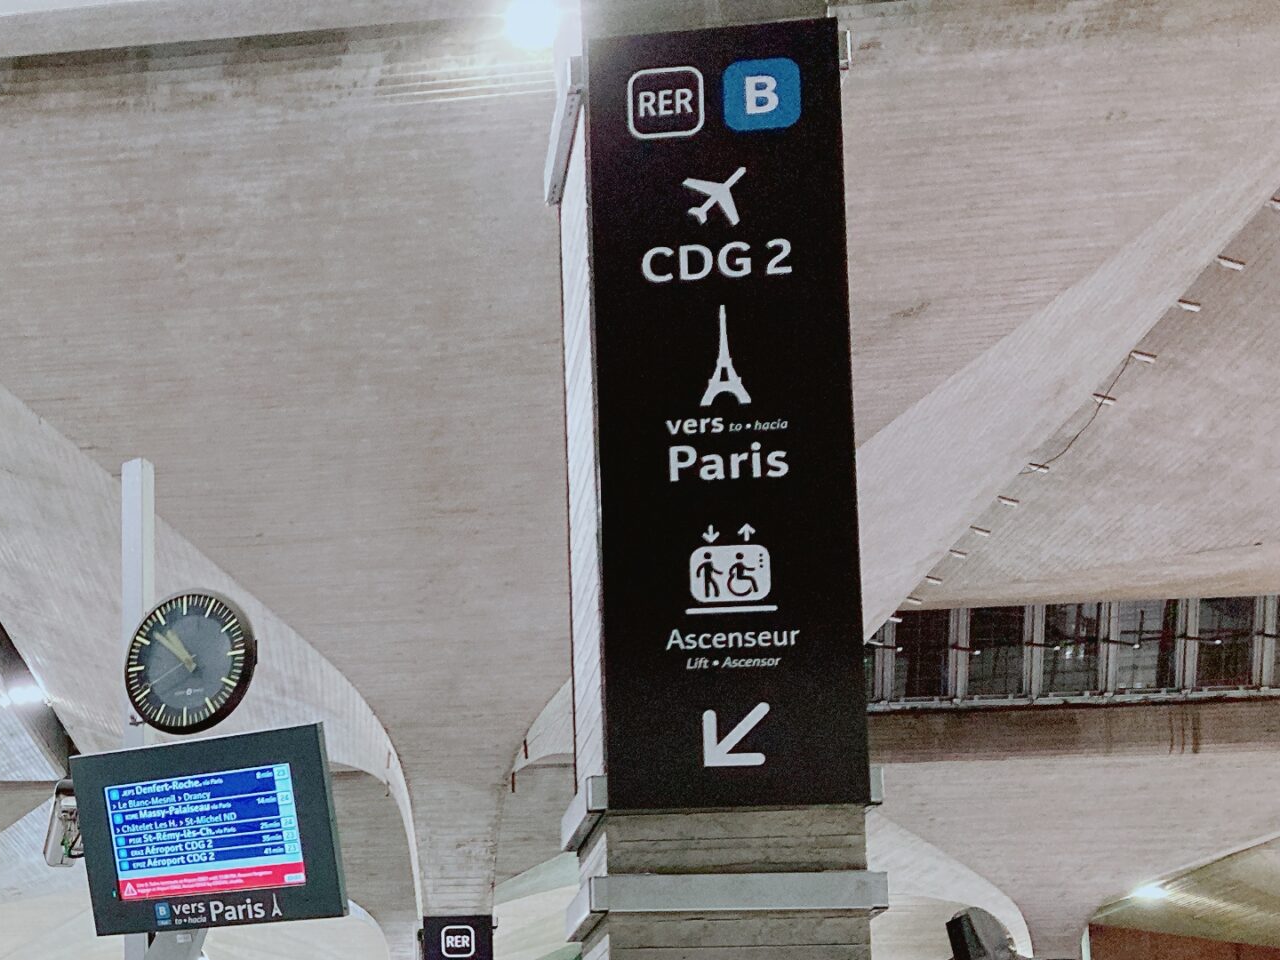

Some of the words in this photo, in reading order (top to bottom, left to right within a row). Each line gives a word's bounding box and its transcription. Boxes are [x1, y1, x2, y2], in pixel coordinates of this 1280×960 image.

[638, 88, 693, 118] RER
[745, 75, 779, 115] B
[641, 241, 752, 283] CDG
[766, 238, 793, 276] 2
[666, 417, 724, 435] vers
[729, 421, 742, 432] to
[754, 418, 788, 431] hacia
[668, 442, 789, 482] Paris
[666, 626, 800, 651] Ascenseur
[686, 656, 709, 670] Lift
[722, 655, 781, 669] Ascensor
[135, 778, 202, 795] Denfert-Roche.
[183, 790, 211, 801] Drancy
[138, 802, 210, 820] Massy-Palaiseau
[154, 820, 167, 829] Les
[184, 813, 222, 825] St-Michel
[223, 812, 236, 820] ND
[144, 842, 183, 855] Aéroport
[184, 840, 205, 850] CDG
[206, 839, 213, 847] 2
[146, 854, 184, 868] Aéroport
[186, 853, 207, 862] CDG
[208, 852, 214, 860] 2
[172, 902, 206, 915] vers
[209, 898, 265, 921] Paris
[446, 935, 470, 948] RER
